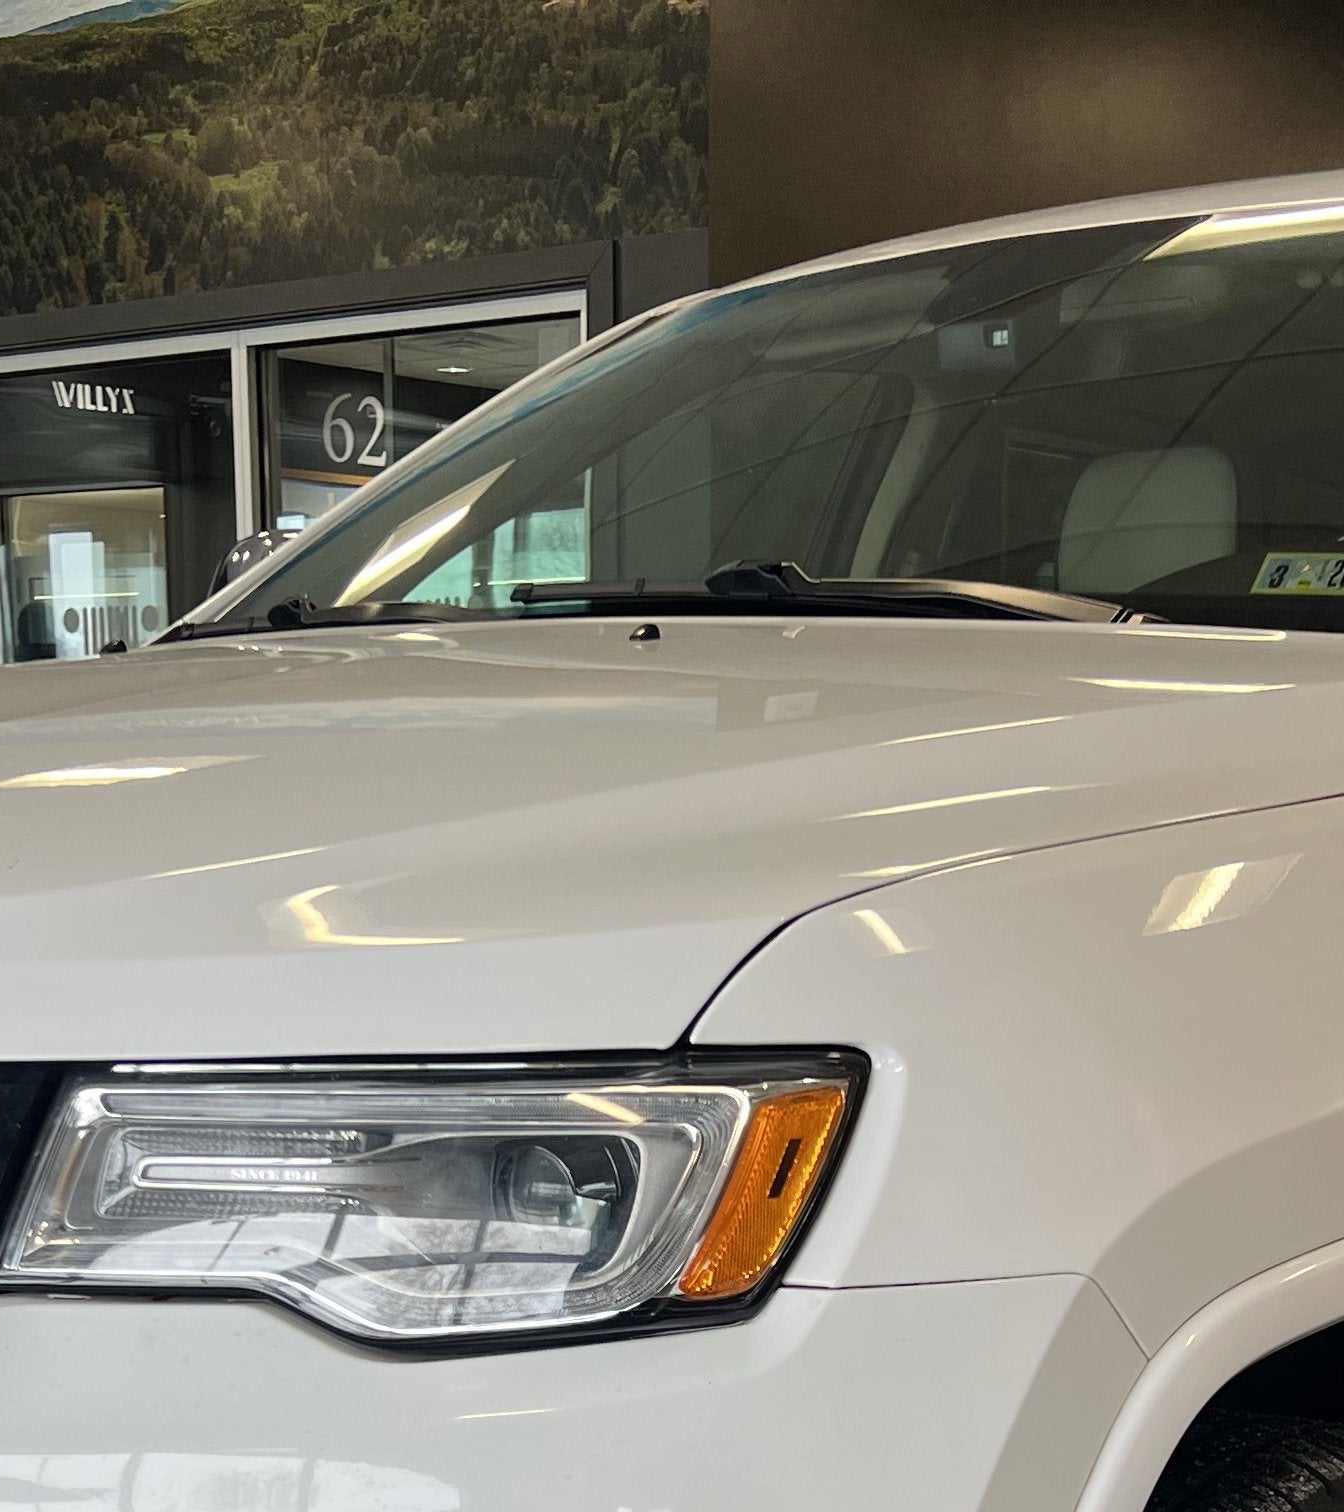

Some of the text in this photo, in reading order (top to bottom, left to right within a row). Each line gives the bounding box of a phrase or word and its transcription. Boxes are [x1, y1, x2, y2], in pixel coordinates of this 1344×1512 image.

[51, 380, 135, 415] WILLYS
[322, 393, 387, 467] 62
[1268, 565, 1290, 588] 3
